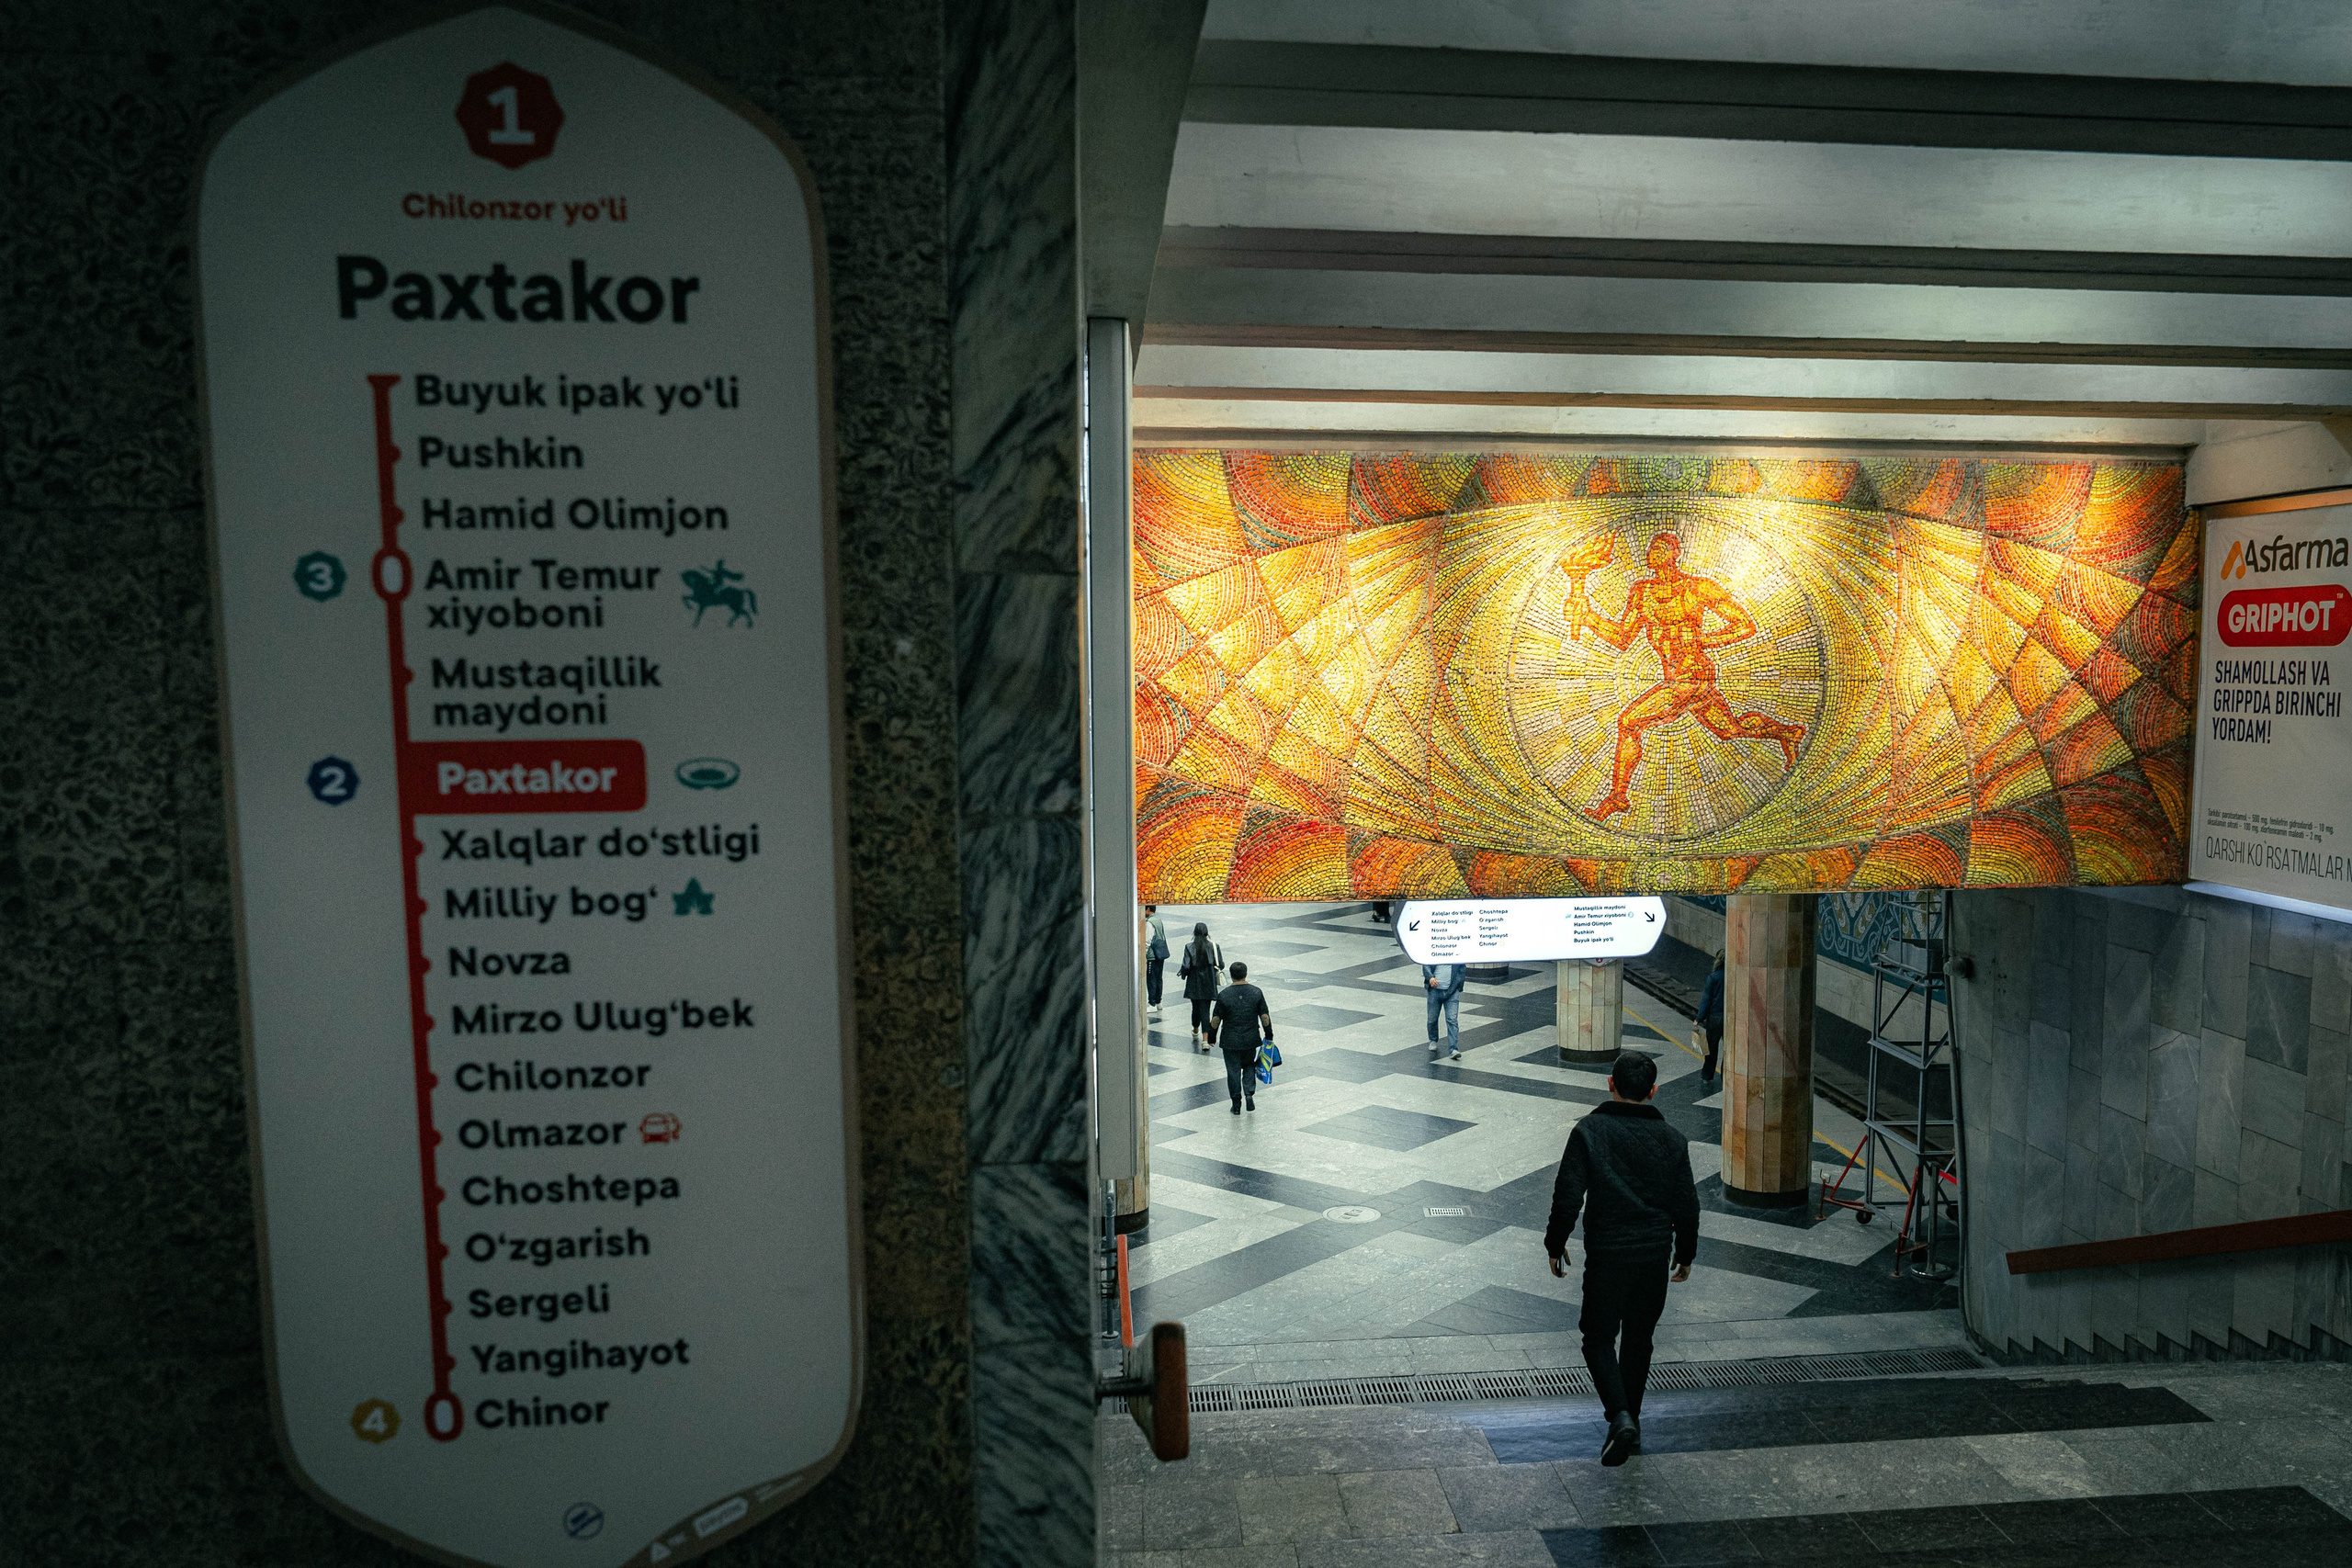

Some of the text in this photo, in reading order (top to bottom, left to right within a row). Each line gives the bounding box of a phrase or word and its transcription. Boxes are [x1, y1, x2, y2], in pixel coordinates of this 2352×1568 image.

[489, 87, 534, 144] 1
[401, 193, 555, 220] Chilonzor
[336, 254, 699, 323] Paxtakor
[415, 374, 546, 414] Buyuk
[560, 375, 643, 414] ipak
[419, 436, 582, 468] Pushkin
[423, 498, 728, 536] Hamid Olimjon
[2245, 536, 2348, 572] Asfarma
[309, 562, 333, 591] 3
[425, 558, 660, 590] Amir Temur
[428, 596, 603, 636] xiyoboni
[2229, 601, 2335, 633] GRIPHOT
[432, 656, 661, 694] Mustaqillik
[2215, 660, 2329, 685] SHAMOLLASH VA
[434, 694, 606, 733] maydoni
[2214, 689, 2341, 716] GRIPPDA BIRINCHI
[2212, 717, 2271, 743] YORDAM!
[322, 767, 345, 795] 2
[438, 761, 616, 794] Paxtakor
[442, 829, 586, 865] Xalqlar
[2206, 836, 2245, 863] QARSHI
[446, 886, 557, 923] Milliy
[449, 947, 570, 976] Novza
[453, 1004, 562, 1034] Mirzo
[455, 1061, 650, 1092] Chilonzor
[458, 1120, 626, 1149] Olmazor
[462, 1174, 679, 1206] Choshtepa
[469, 1283, 609, 1323] Sergeli
[470, 1339, 689, 1378] Yangihayot
[363, 1408, 386, 1433] 4
[475, 1396, 609, 1429] Chinor
